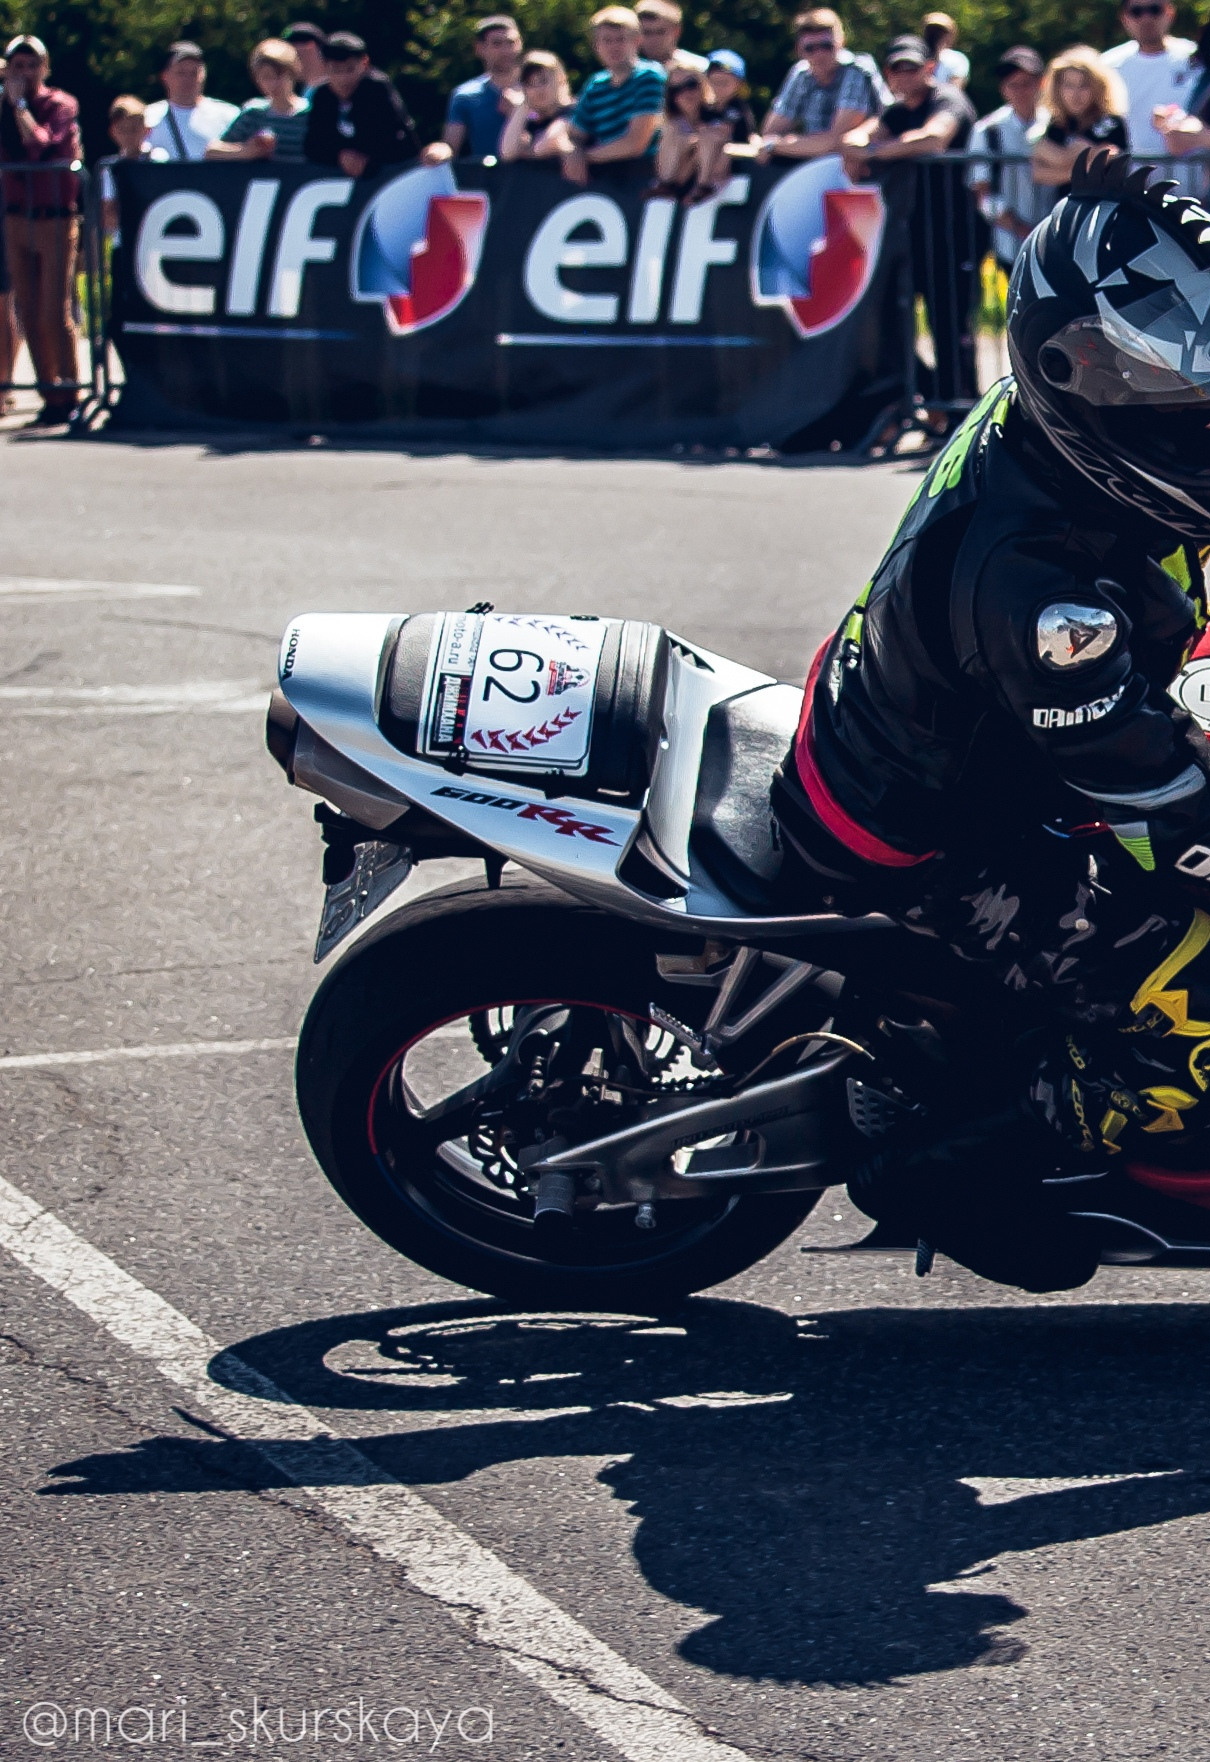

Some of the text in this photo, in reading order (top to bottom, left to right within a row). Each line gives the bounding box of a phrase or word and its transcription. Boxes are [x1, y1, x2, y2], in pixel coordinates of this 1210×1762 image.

[135, 178, 353, 319] elf
[524, 176, 751, 324] elf
[281, 628, 301, 682] HONDA
[483, 648, 545, 704] 62
